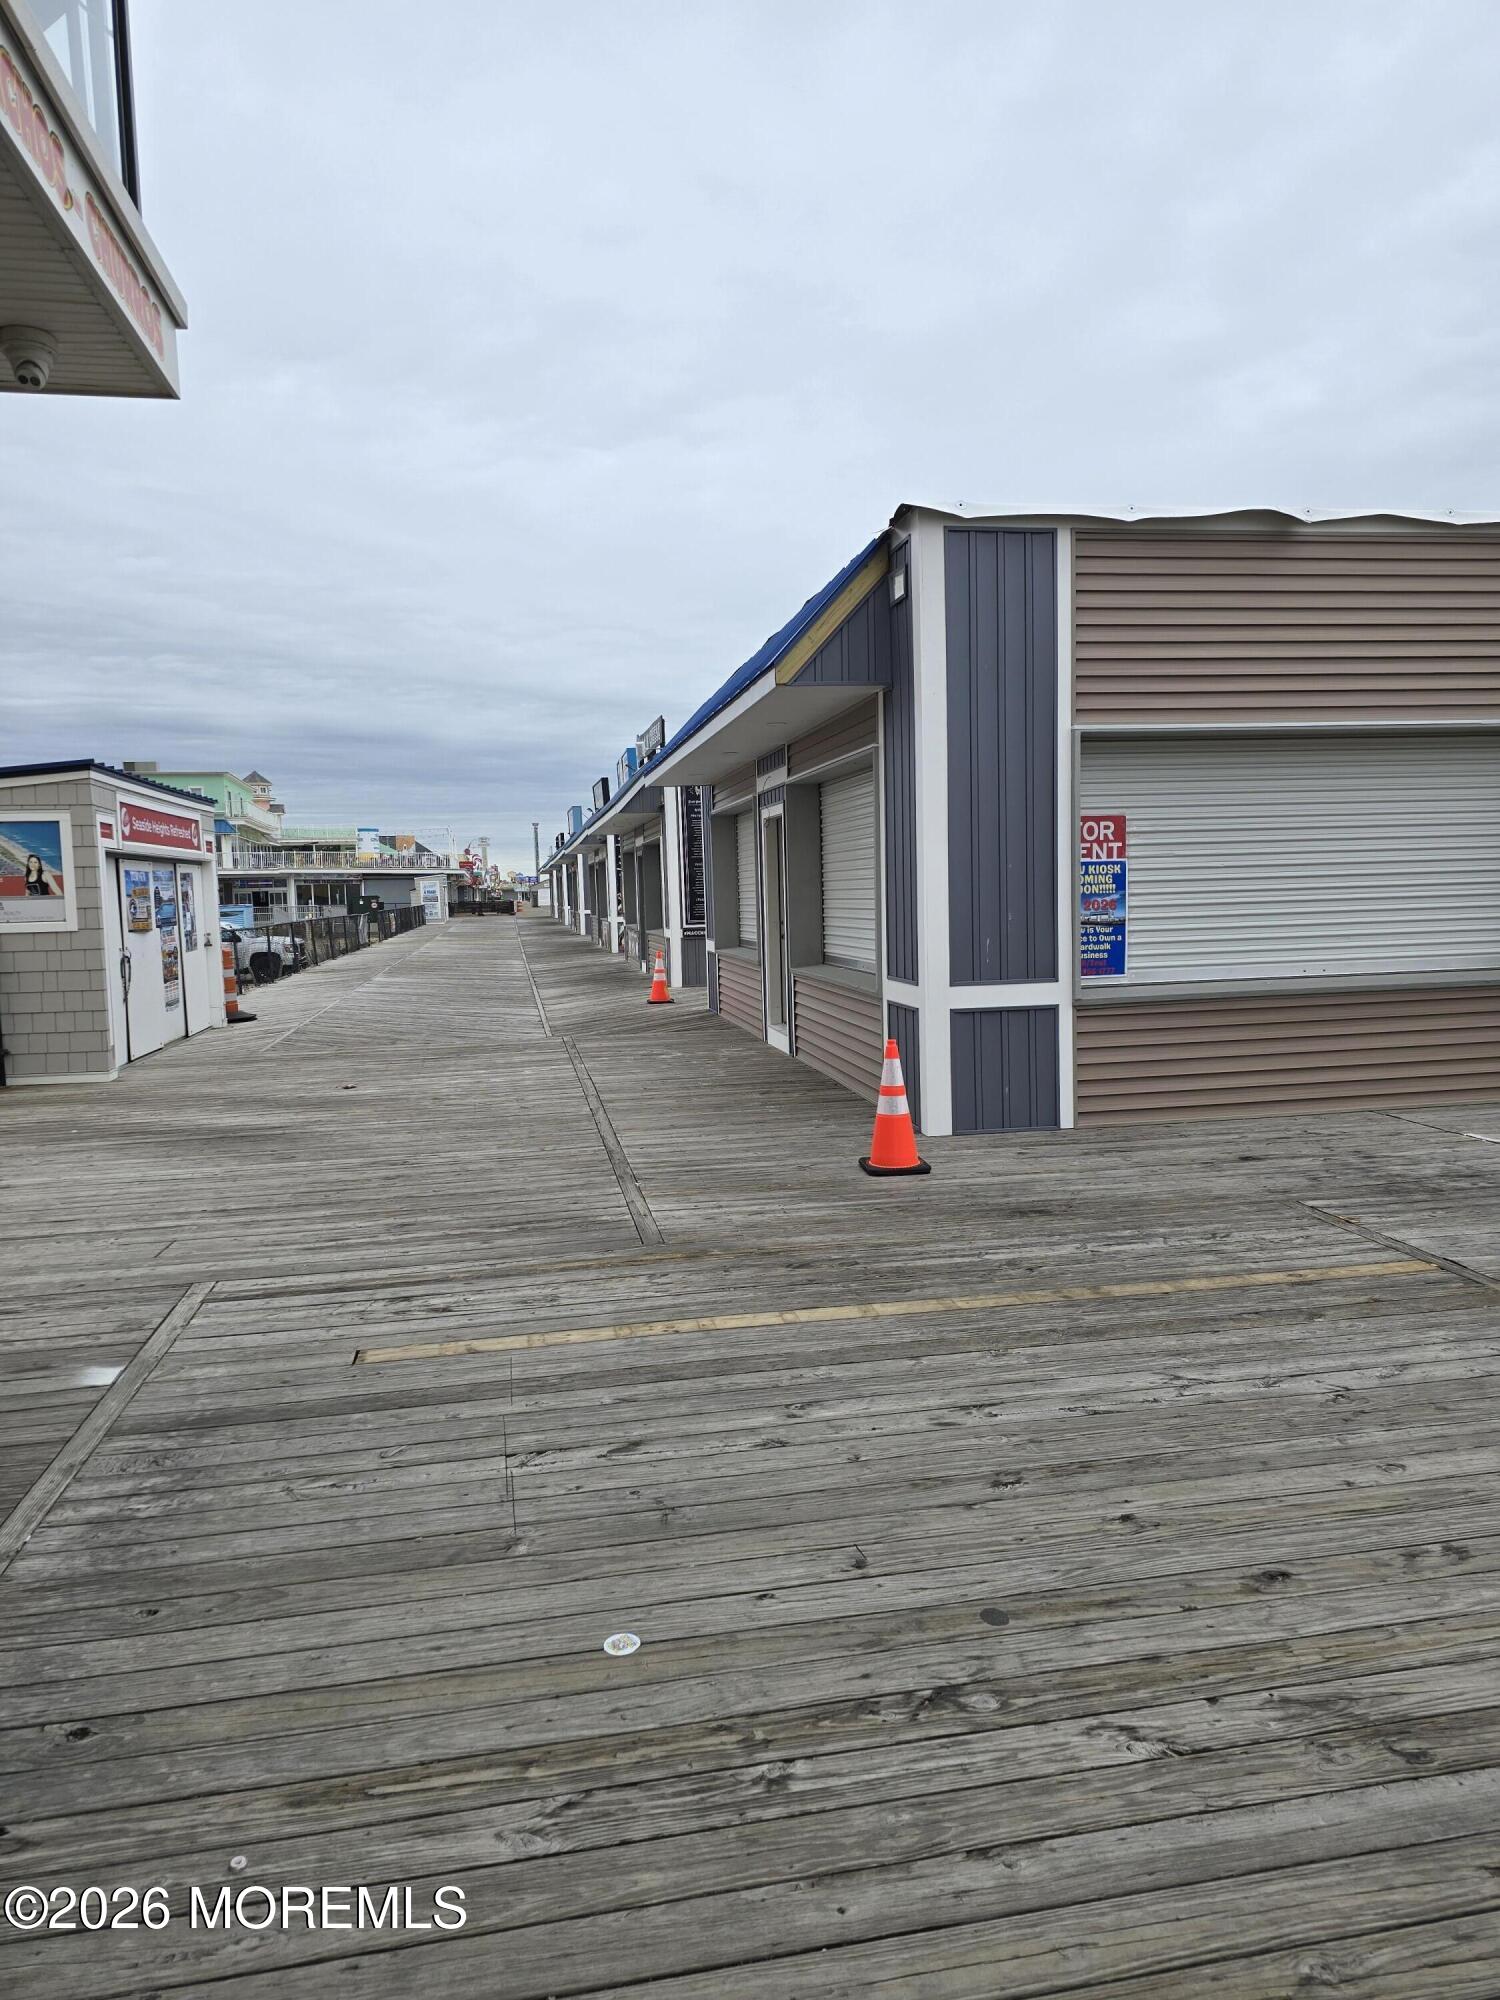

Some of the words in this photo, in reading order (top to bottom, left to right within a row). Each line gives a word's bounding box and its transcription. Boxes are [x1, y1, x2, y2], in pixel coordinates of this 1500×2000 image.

[132, 817, 152, 832] Seaside
[152, 820, 170, 837] Heights
[1080, 821, 1115, 841] OR
[1080, 842, 1123, 860] ENT
[1088, 864, 1121, 874] KIOSK
[1080, 874, 1113, 884] OMING
[1083, 899, 1117, 911] 2026
[1095, 925, 1114, 933] Your
[1080, 942, 1111, 951] ardwalk
